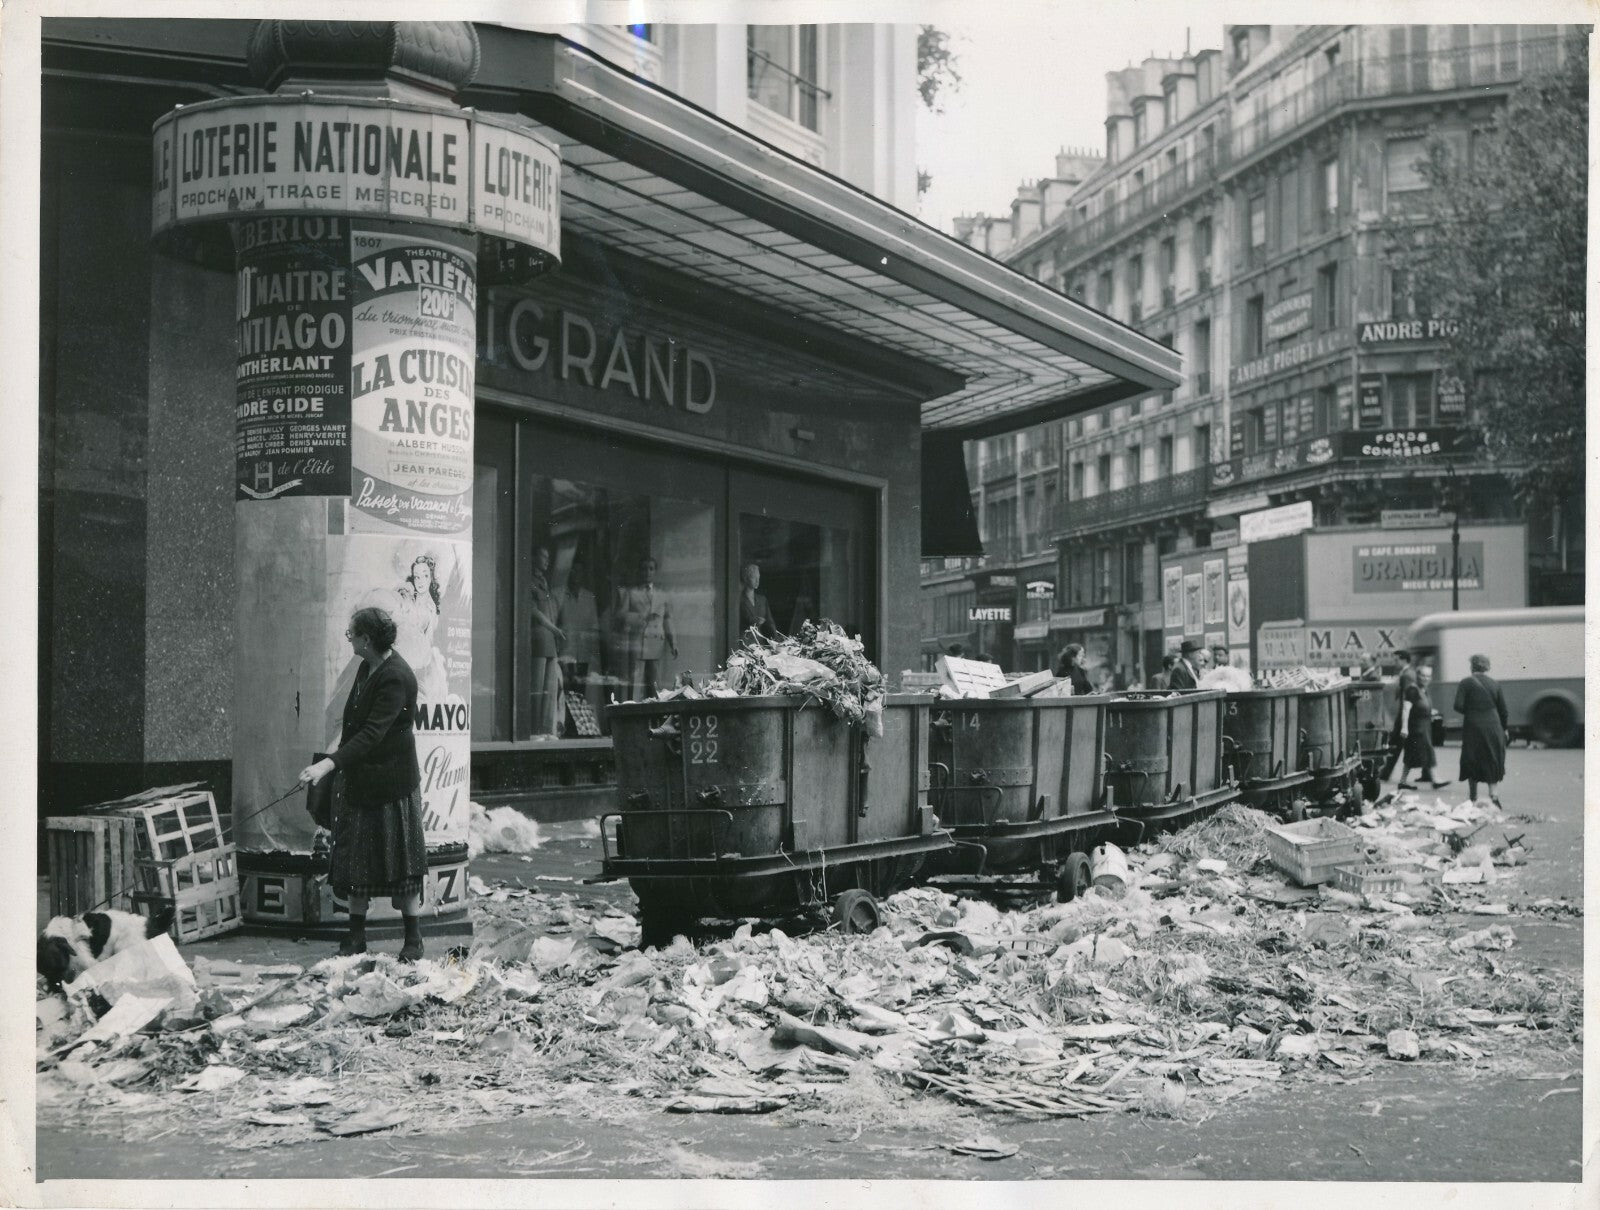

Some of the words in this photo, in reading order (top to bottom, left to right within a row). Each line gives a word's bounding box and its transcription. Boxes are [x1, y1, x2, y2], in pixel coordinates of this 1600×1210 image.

[183, 122, 277, 183] LOTERIE
[294, 121, 457, 185] NATIONALE
[484, 142, 552, 213] LOTERIE
[181, 186, 257, 208] PROCHAIN
[267, 185, 341, 199] TIRAGE
[355, 187, 457, 211] MERCREDI
[484, 204, 545, 235] PROCHAIN
[354, 236, 382, 249] 1807
[451, 256, 465, 269] DES
[287, 304, 304, 312] DE
[355, 305, 378, 322] du
[1361, 321, 1423, 342] ANDRE
[1428, 320, 1459, 338] PIG
[486, 289, 716, 414] IGRAND
[236, 355, 334, 379] ONTHERLANT
[352, 354, 395, 400] LA
[294, 384, 345, 395] PRODIGUE
[424, 386, 450, 400] DES
[272, 397, 324, 413] GIDE
[290, 424, 320, 432] GEORGES
[378, 397, 471, 442] ANGES
[281, 446, 314, 454] POMMIER
[290, 439, 310, 447] DENIS
[1361, 441, 1441, 457] COMMERCE
[393, 463, 425, 474] JEAN
[968, 608, 1011, 621] LAYETTE
[1310, 629, 1396, 650] MAX
[689, 714, 719, 739] 22
[961, 712, 981, 731] 14
[690, 740, 719, 765] 22
